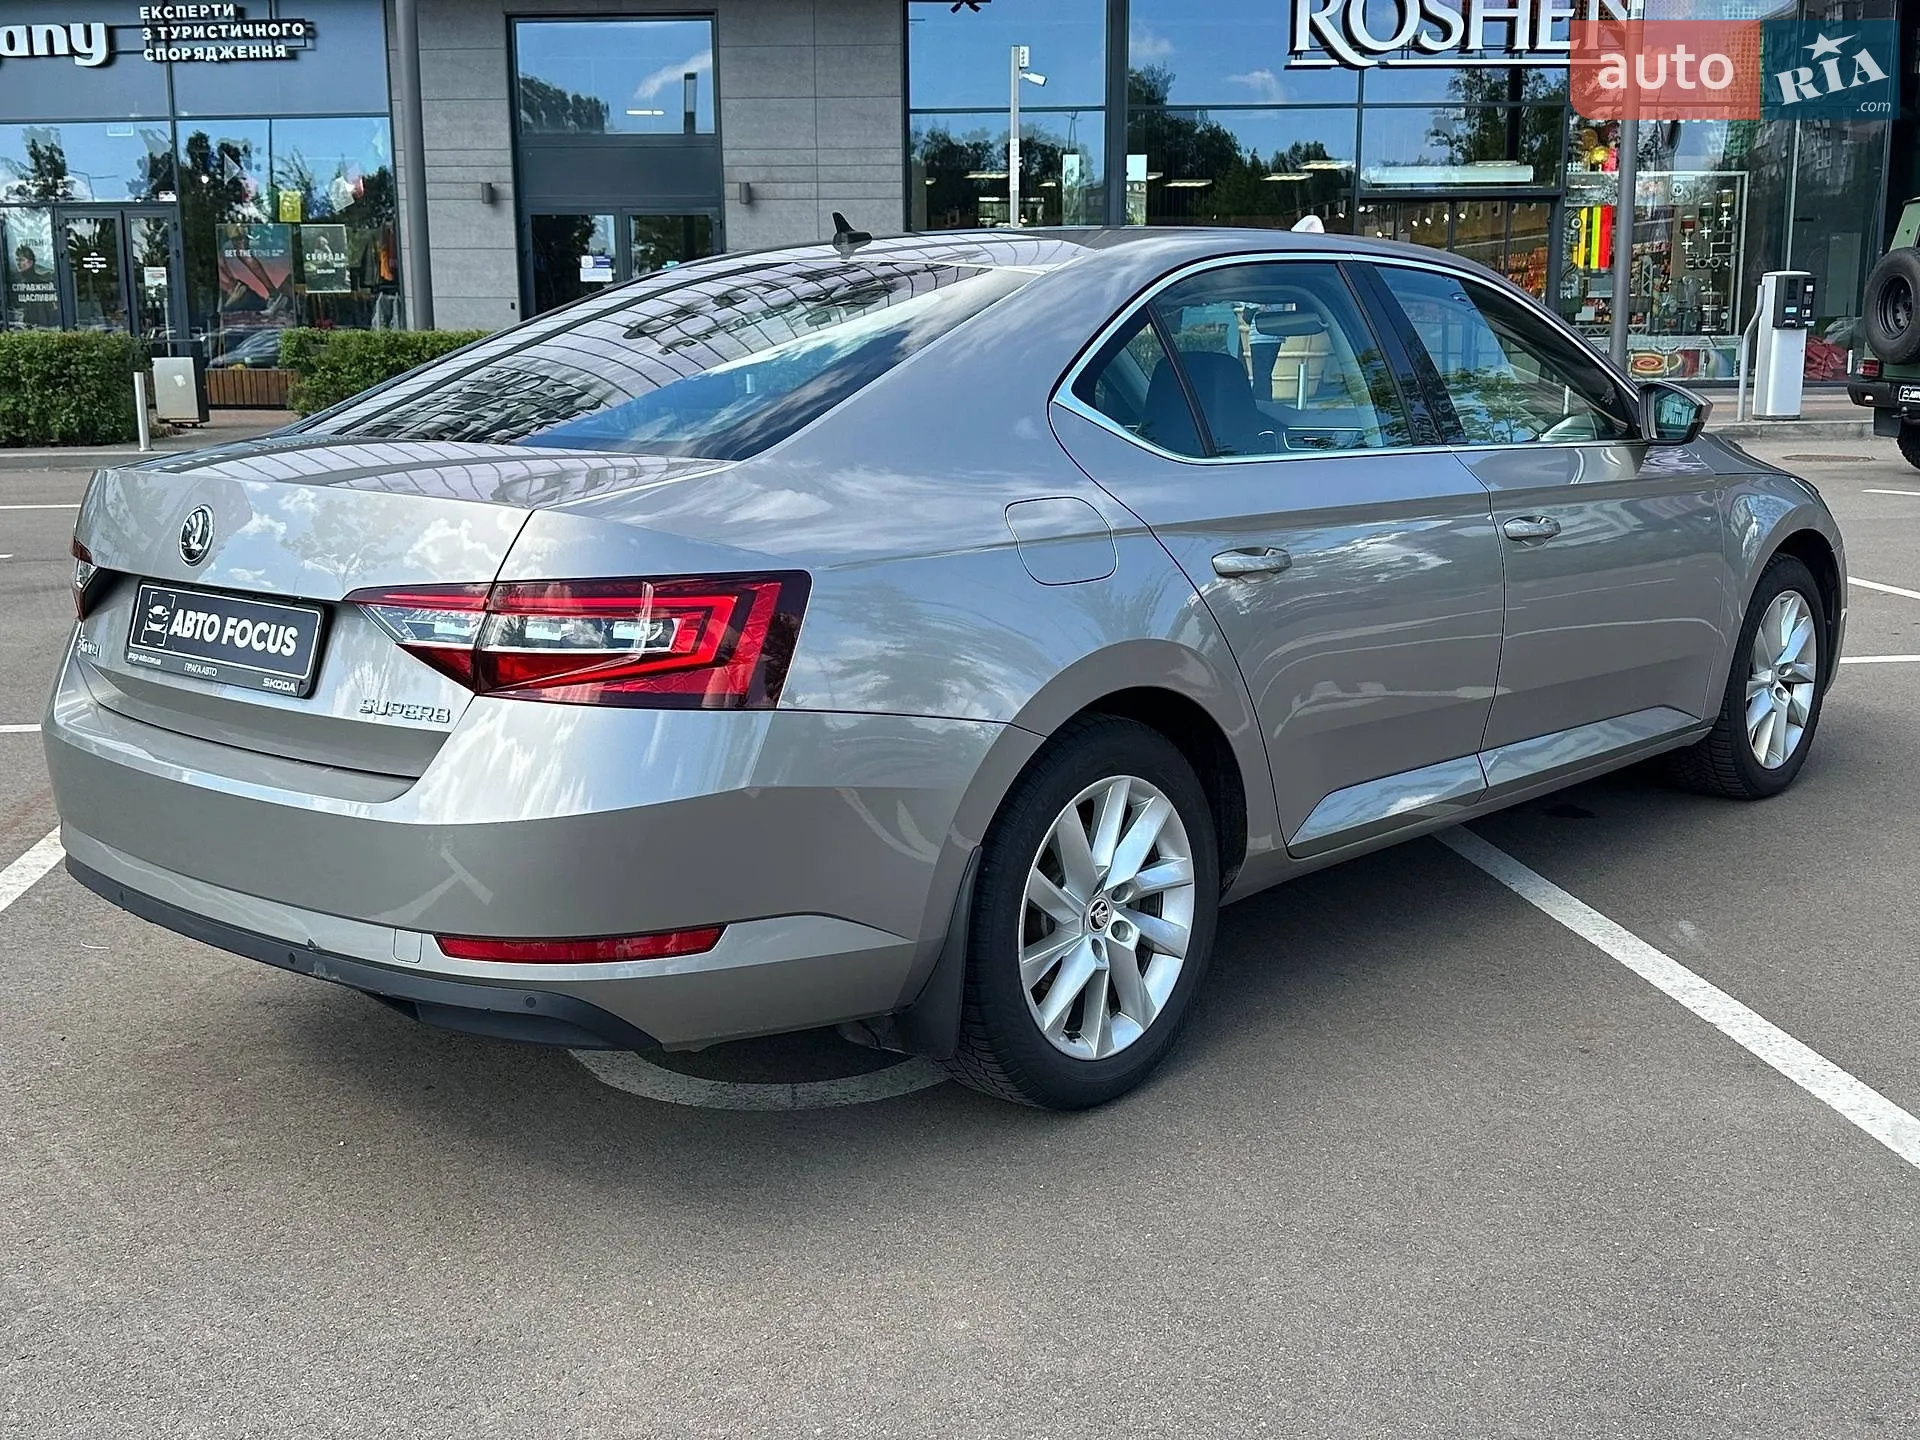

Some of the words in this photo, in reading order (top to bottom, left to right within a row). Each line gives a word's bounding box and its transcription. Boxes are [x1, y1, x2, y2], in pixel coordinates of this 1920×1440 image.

[140, 3, 235, 20] ЕКСПЕРТИ
[160, 23, 304, 40] ТУРИСТИЧНОГО
[143, 44, 287, 62] СПОРЯДЖЕННЯ
[169, 608, 221, 643] АВТО
[221, 616, 299, 657] FOCUS
[359, 698, 451, 723] SUPERB
